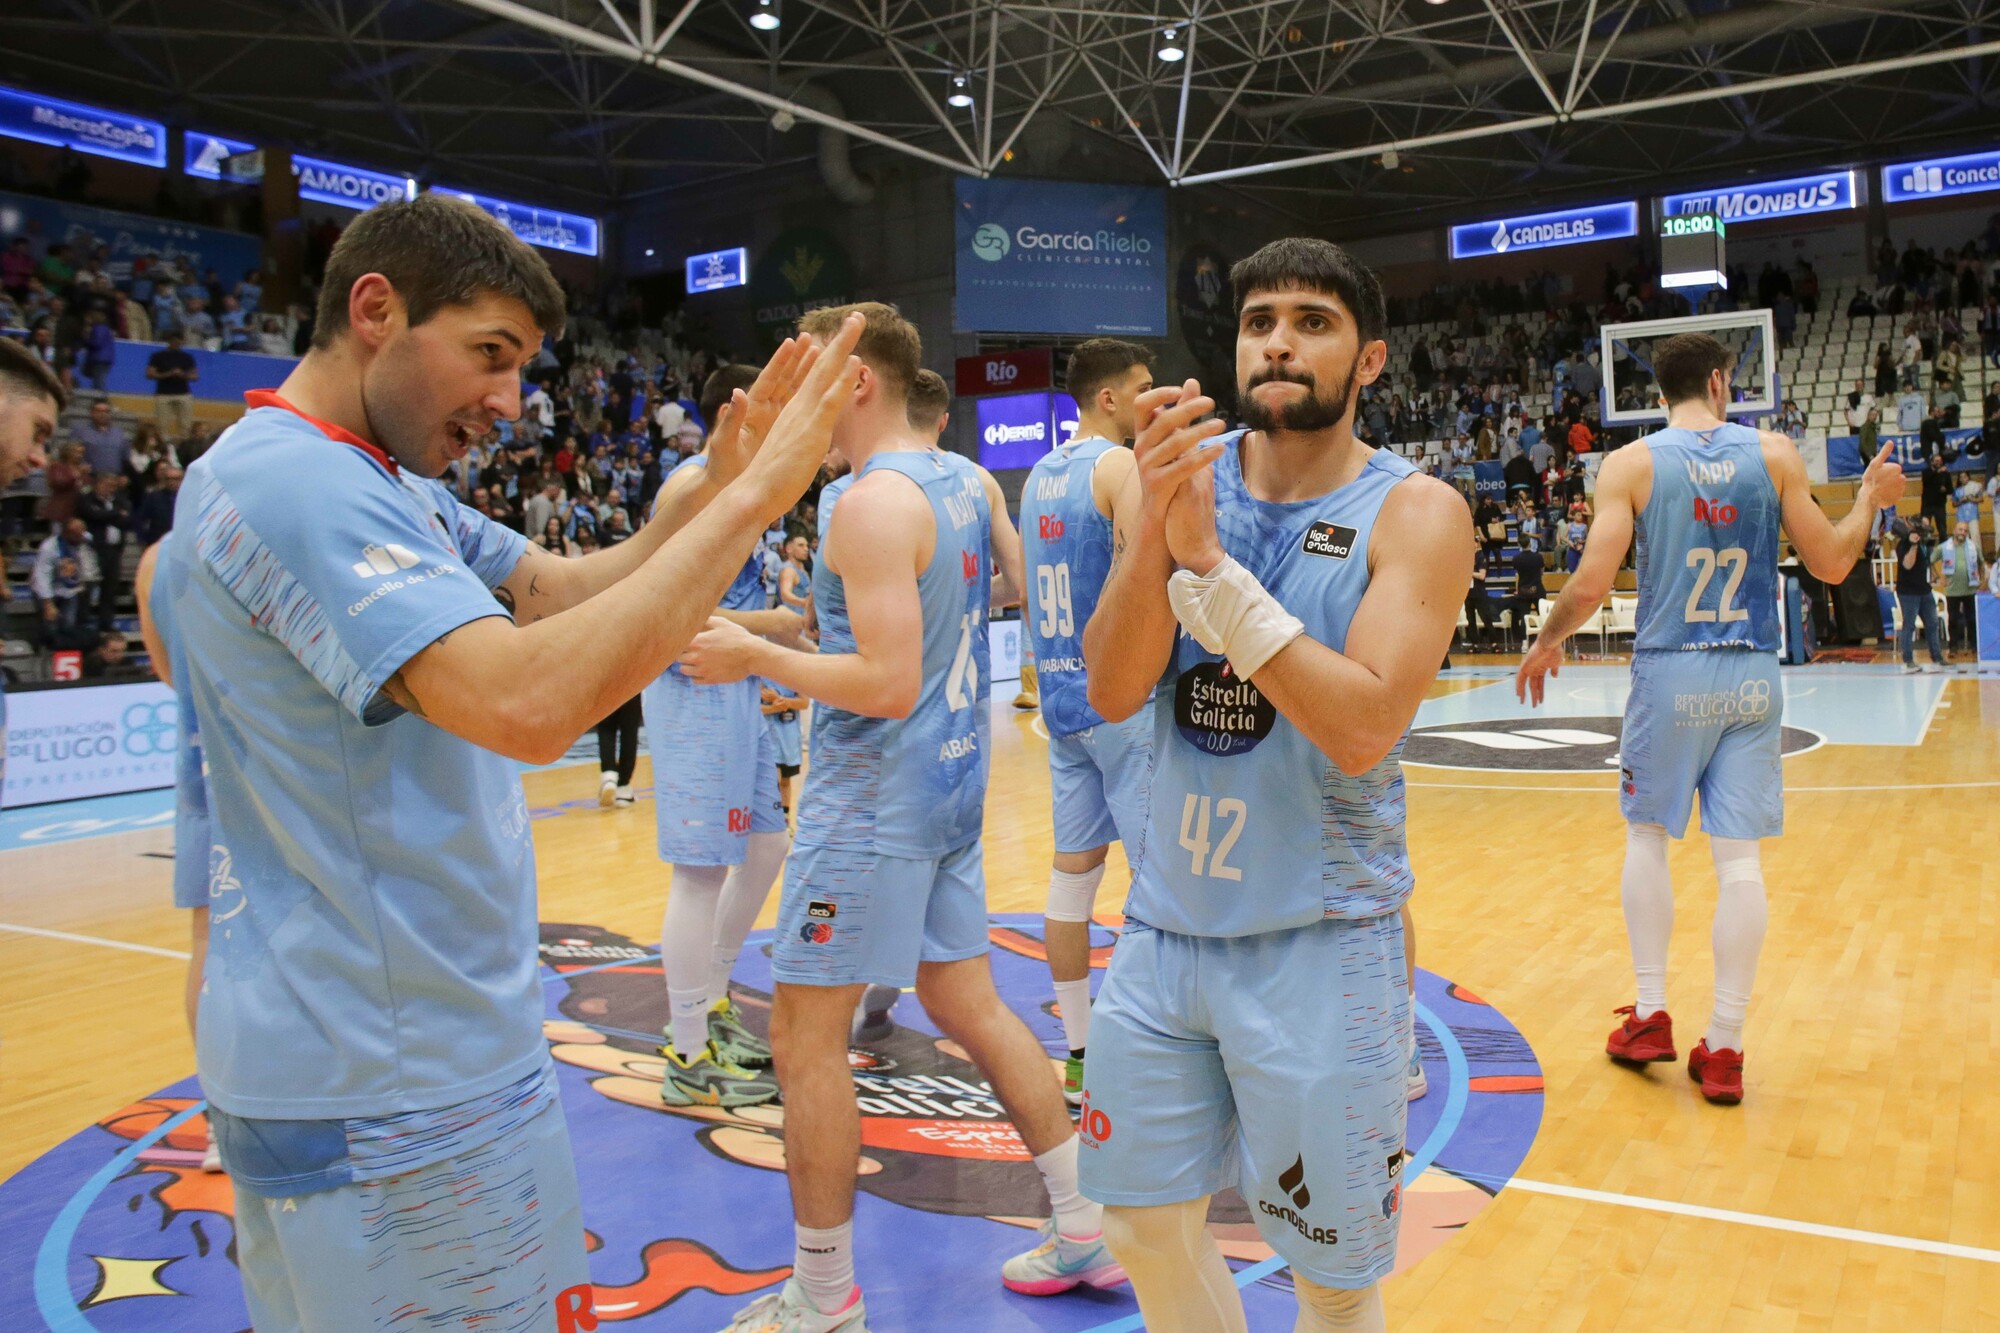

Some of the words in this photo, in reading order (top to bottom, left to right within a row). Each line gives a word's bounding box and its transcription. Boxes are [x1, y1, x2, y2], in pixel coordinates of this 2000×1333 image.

[1512, 218, 1595, 245] CANDELAS
[1663, 215, 1713, 235] 10:00
[1307, 541, 1348, 555] endesa
[1309, 529, 1329, 542] liga
[347, 580, 404, 617] Concello
[406, 572, 426, 585] de
[426, 563, 458, 580] Lug
[1684, 548, 1749, 624] 22
[1037, 563, 1074, 638] 99
[53, 655, 81, 681] 5
[1191, 676, 1257, 707] Estrella
[1191, 701, 1255, 731] Galicia
[1675, 702, 1688, 712] DE
[1689, 700, 1736, 718] LUGO
[34, 735, 116, 763] LUGO
[1179, 793, 1246, 881] 42
[810, 908, 830, 917] acb
[1259, 1200, 1338, 1245] CANDELAS
